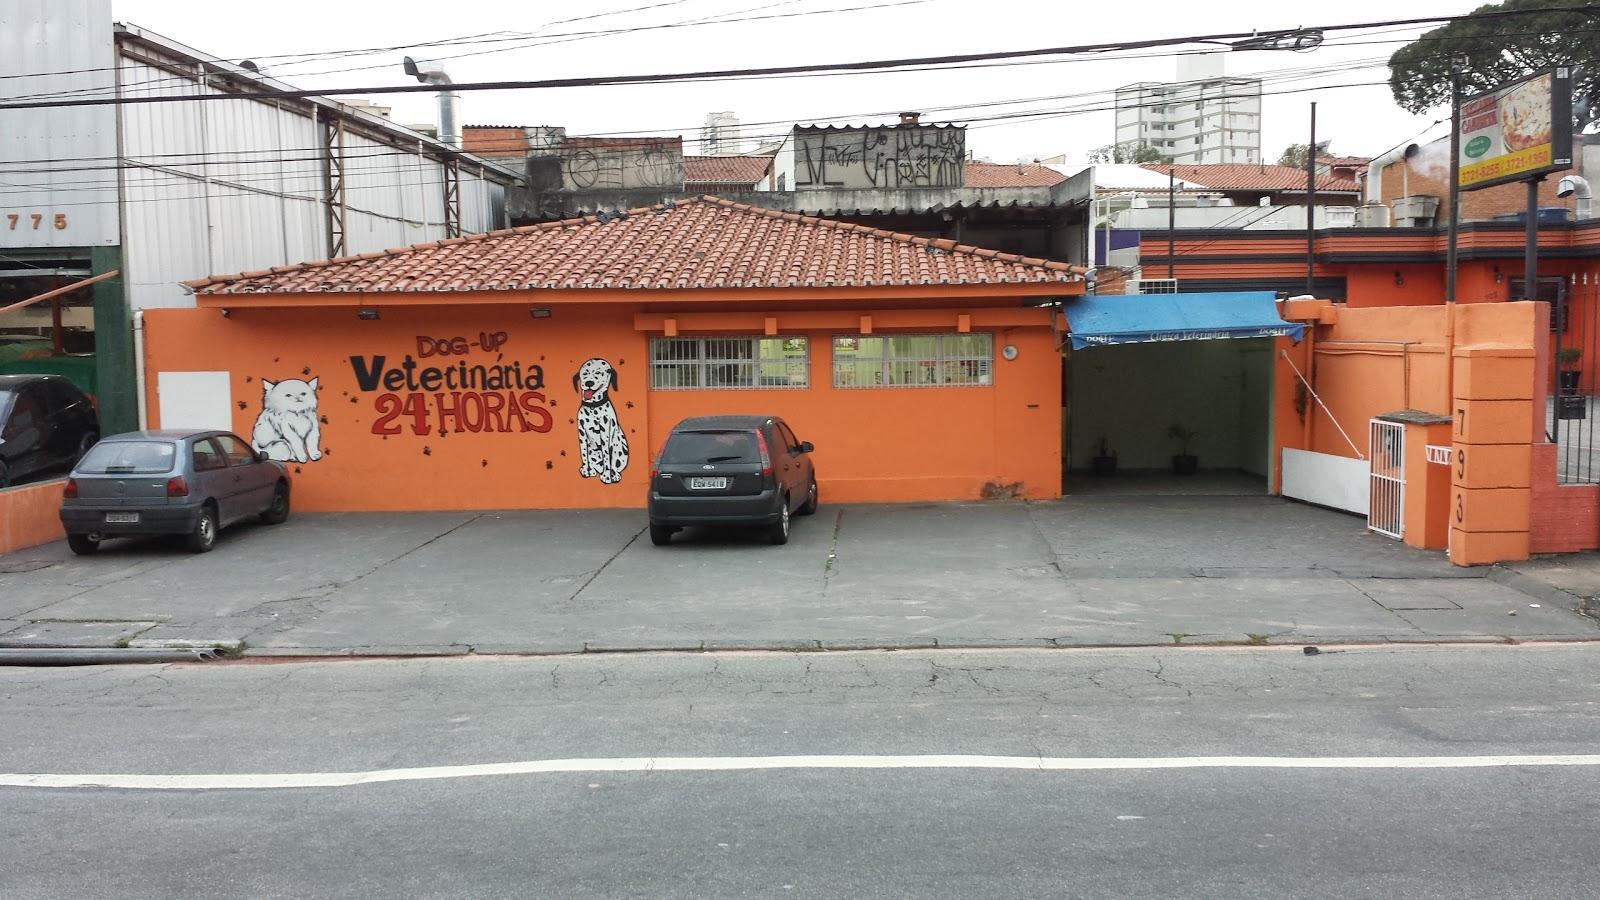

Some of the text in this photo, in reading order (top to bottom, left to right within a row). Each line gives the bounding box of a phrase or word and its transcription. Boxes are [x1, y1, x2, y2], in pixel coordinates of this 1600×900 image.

[7, 213, 67, 230] 775
[350, 353, 545, 391] Veterinária
[371, 391, 553, 435] 24 HORAS
